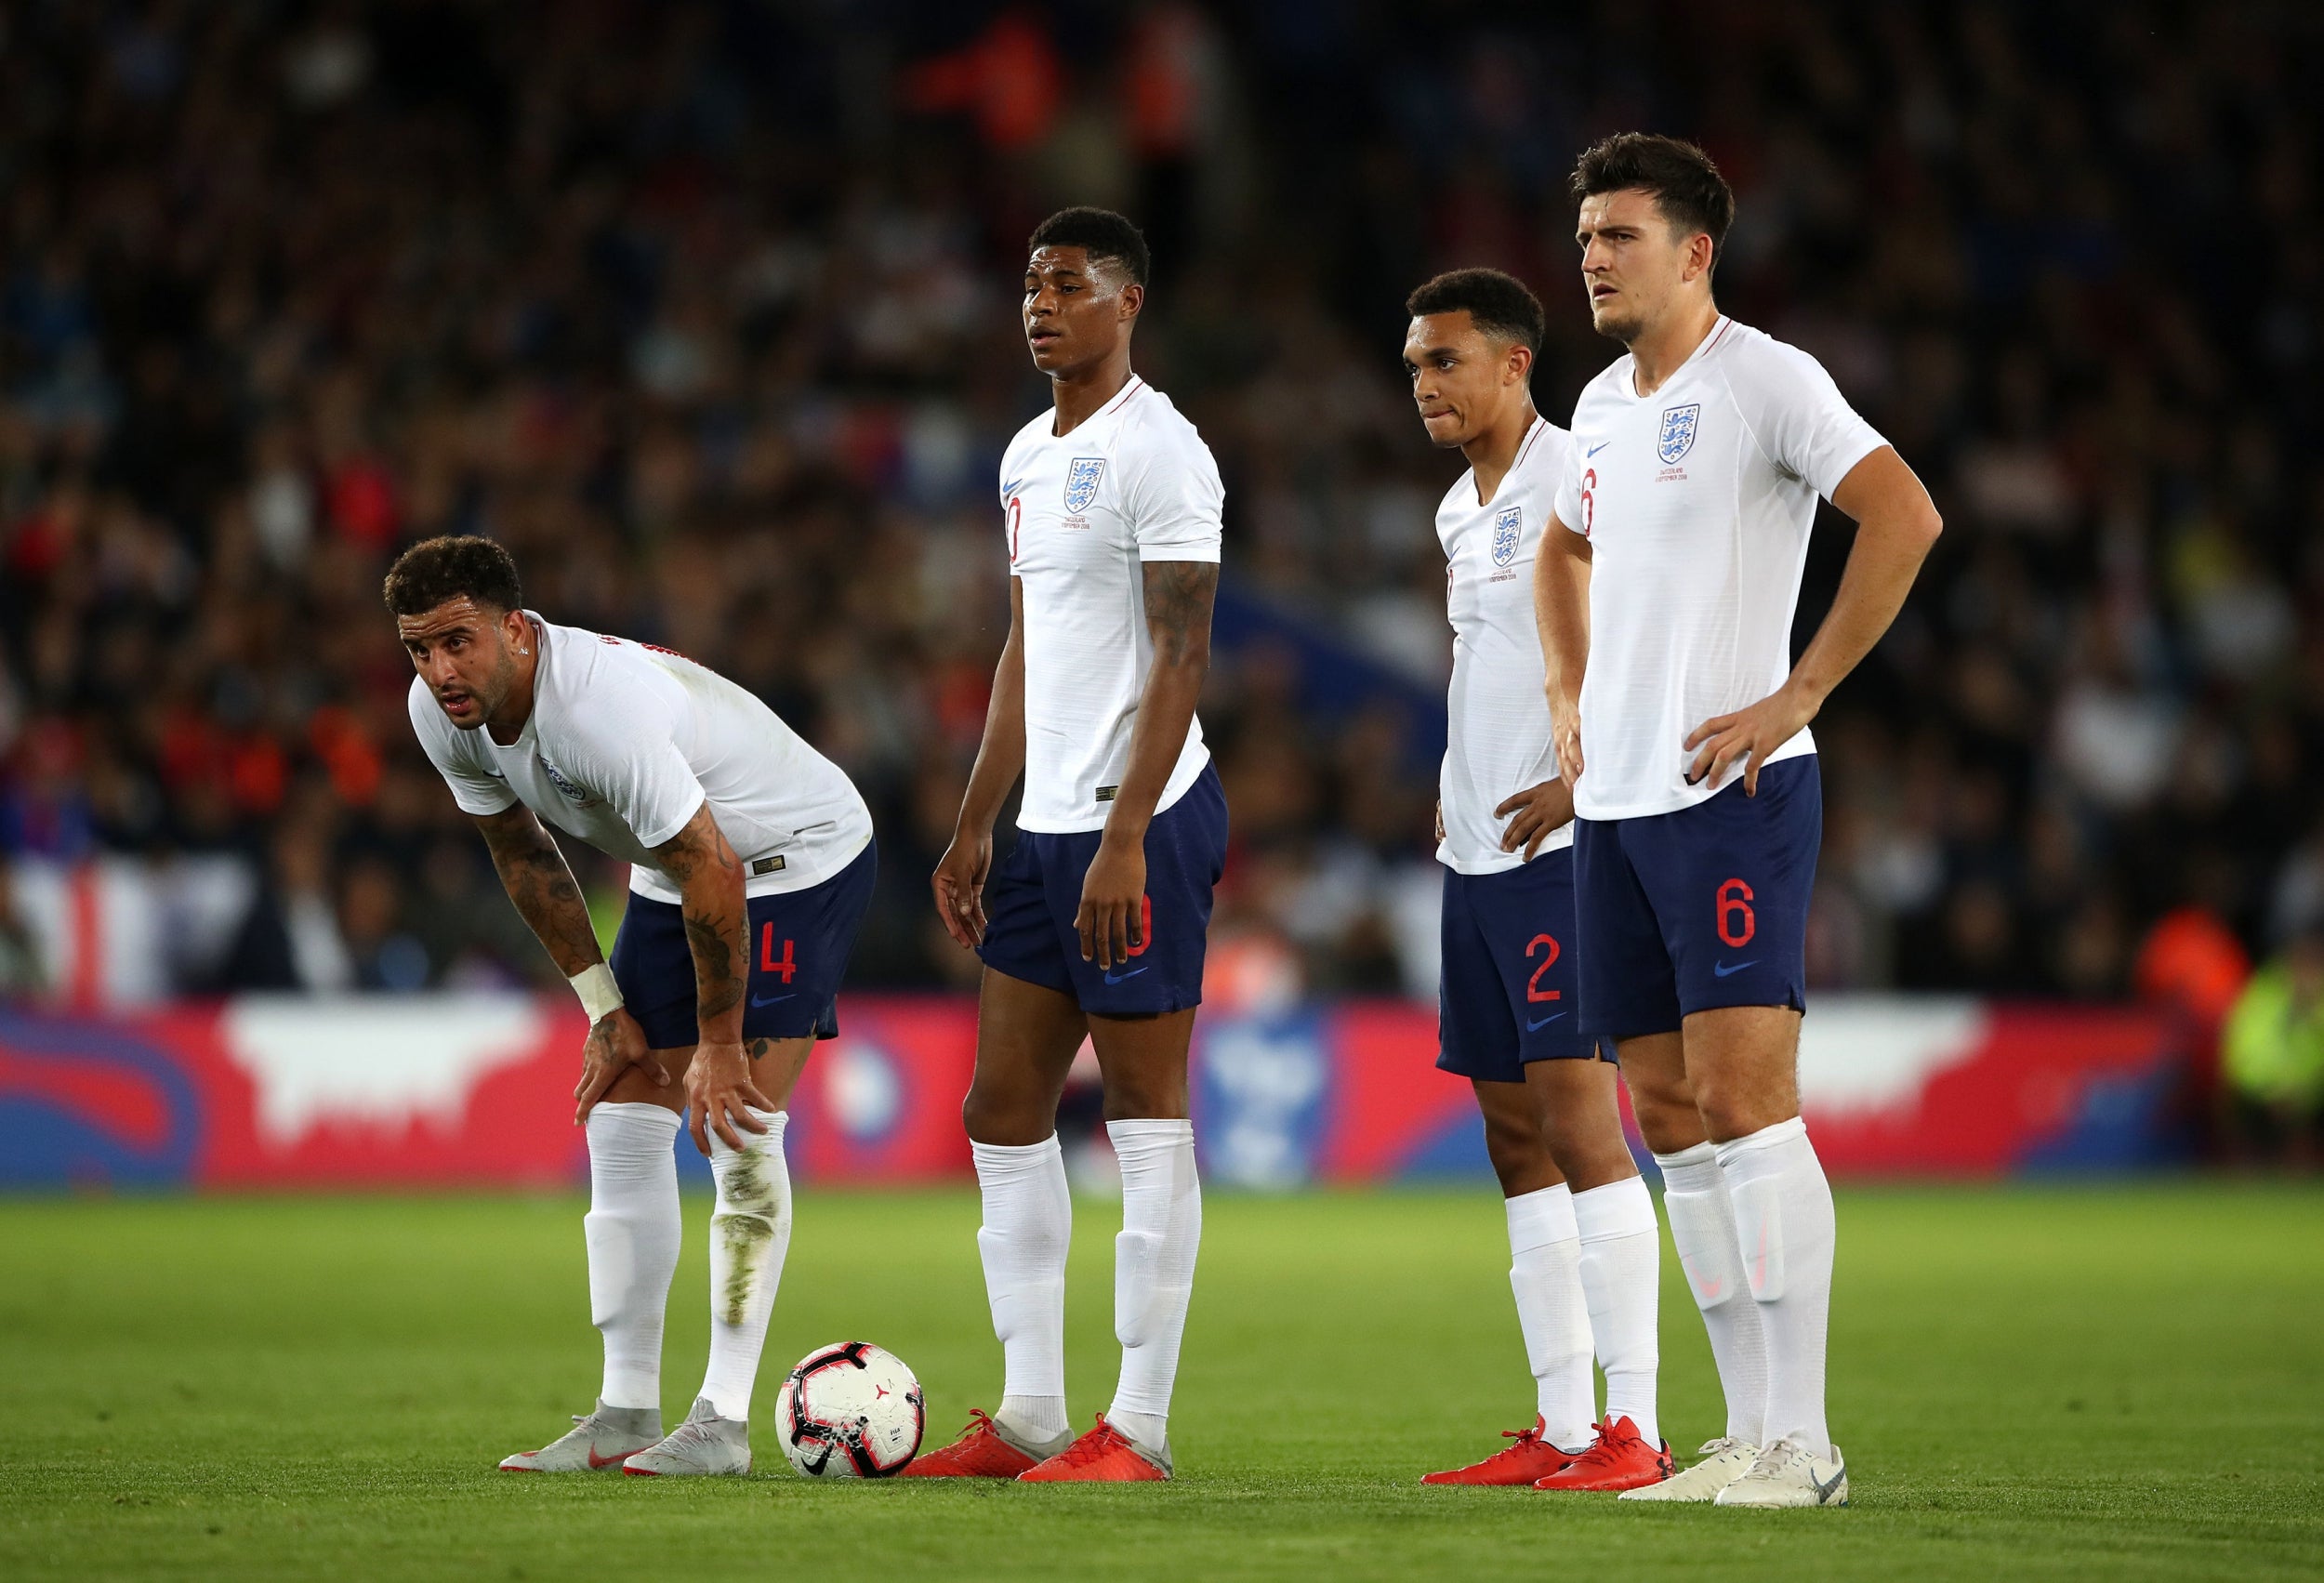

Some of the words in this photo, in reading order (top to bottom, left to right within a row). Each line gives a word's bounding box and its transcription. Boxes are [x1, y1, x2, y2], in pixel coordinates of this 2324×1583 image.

[1581, 468, 1596, 537] 6
[1716, 878, 1755, 948] 6
[760, 921, 797, 984] 4
[1525, 933, 1561, 1003] 2
